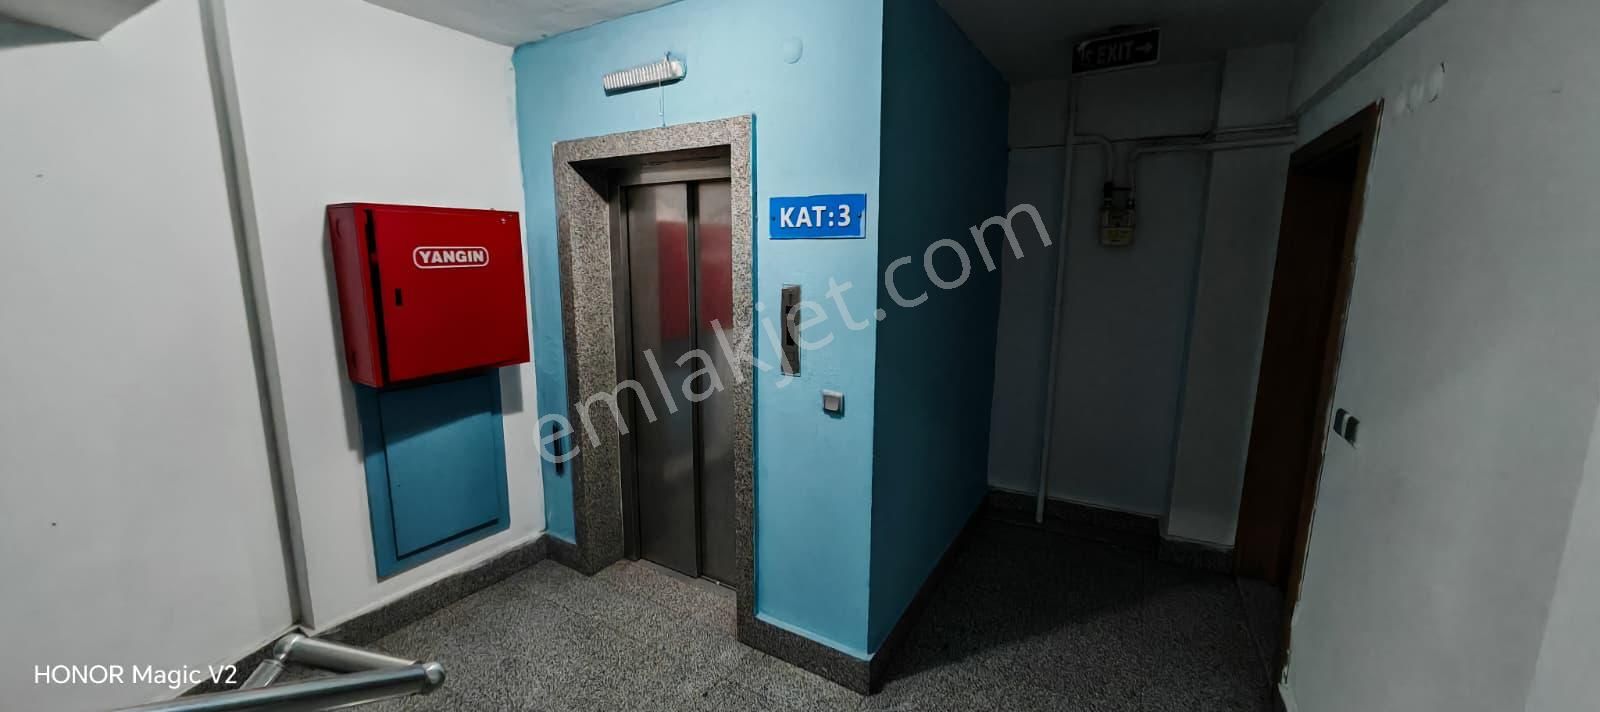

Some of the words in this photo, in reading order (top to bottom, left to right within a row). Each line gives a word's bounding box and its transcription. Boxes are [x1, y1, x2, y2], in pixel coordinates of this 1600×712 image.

[1096, 40, 1135, 65] EXIT
[780, 204, 851, 228] KAT:3
[419, 249, 485, 264] YANGIN
